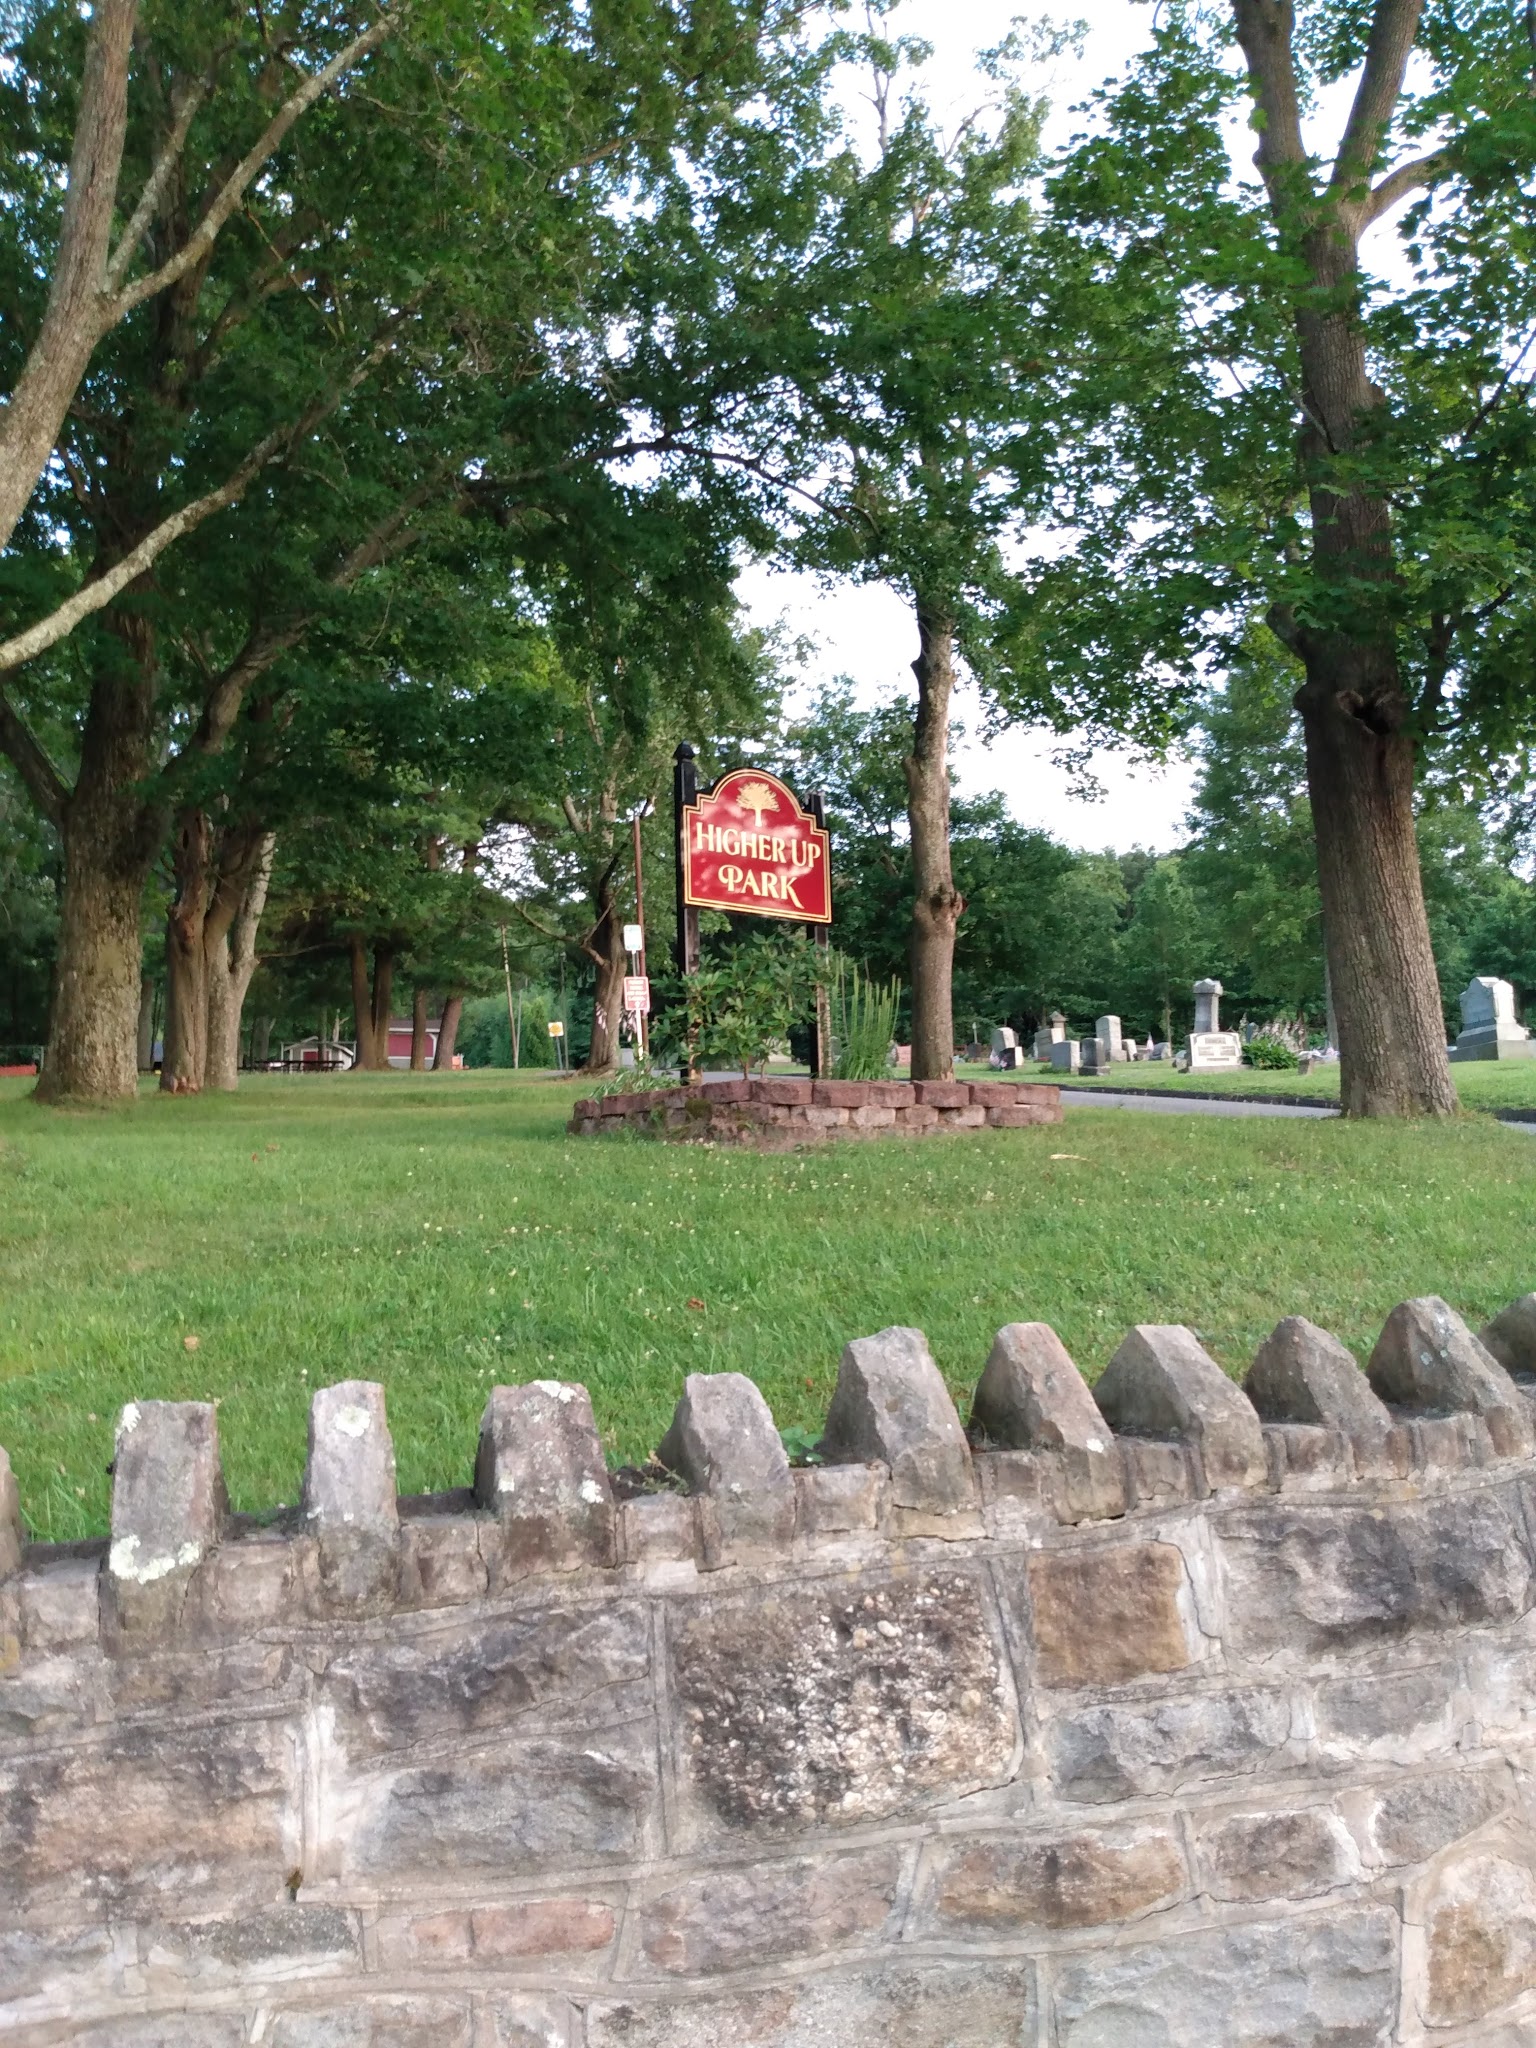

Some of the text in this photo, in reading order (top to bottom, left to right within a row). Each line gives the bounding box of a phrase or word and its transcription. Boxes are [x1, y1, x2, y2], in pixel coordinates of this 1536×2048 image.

[696, 822, 821, 868] HIGHER UP
[718, 864, 804, 909] PARK
